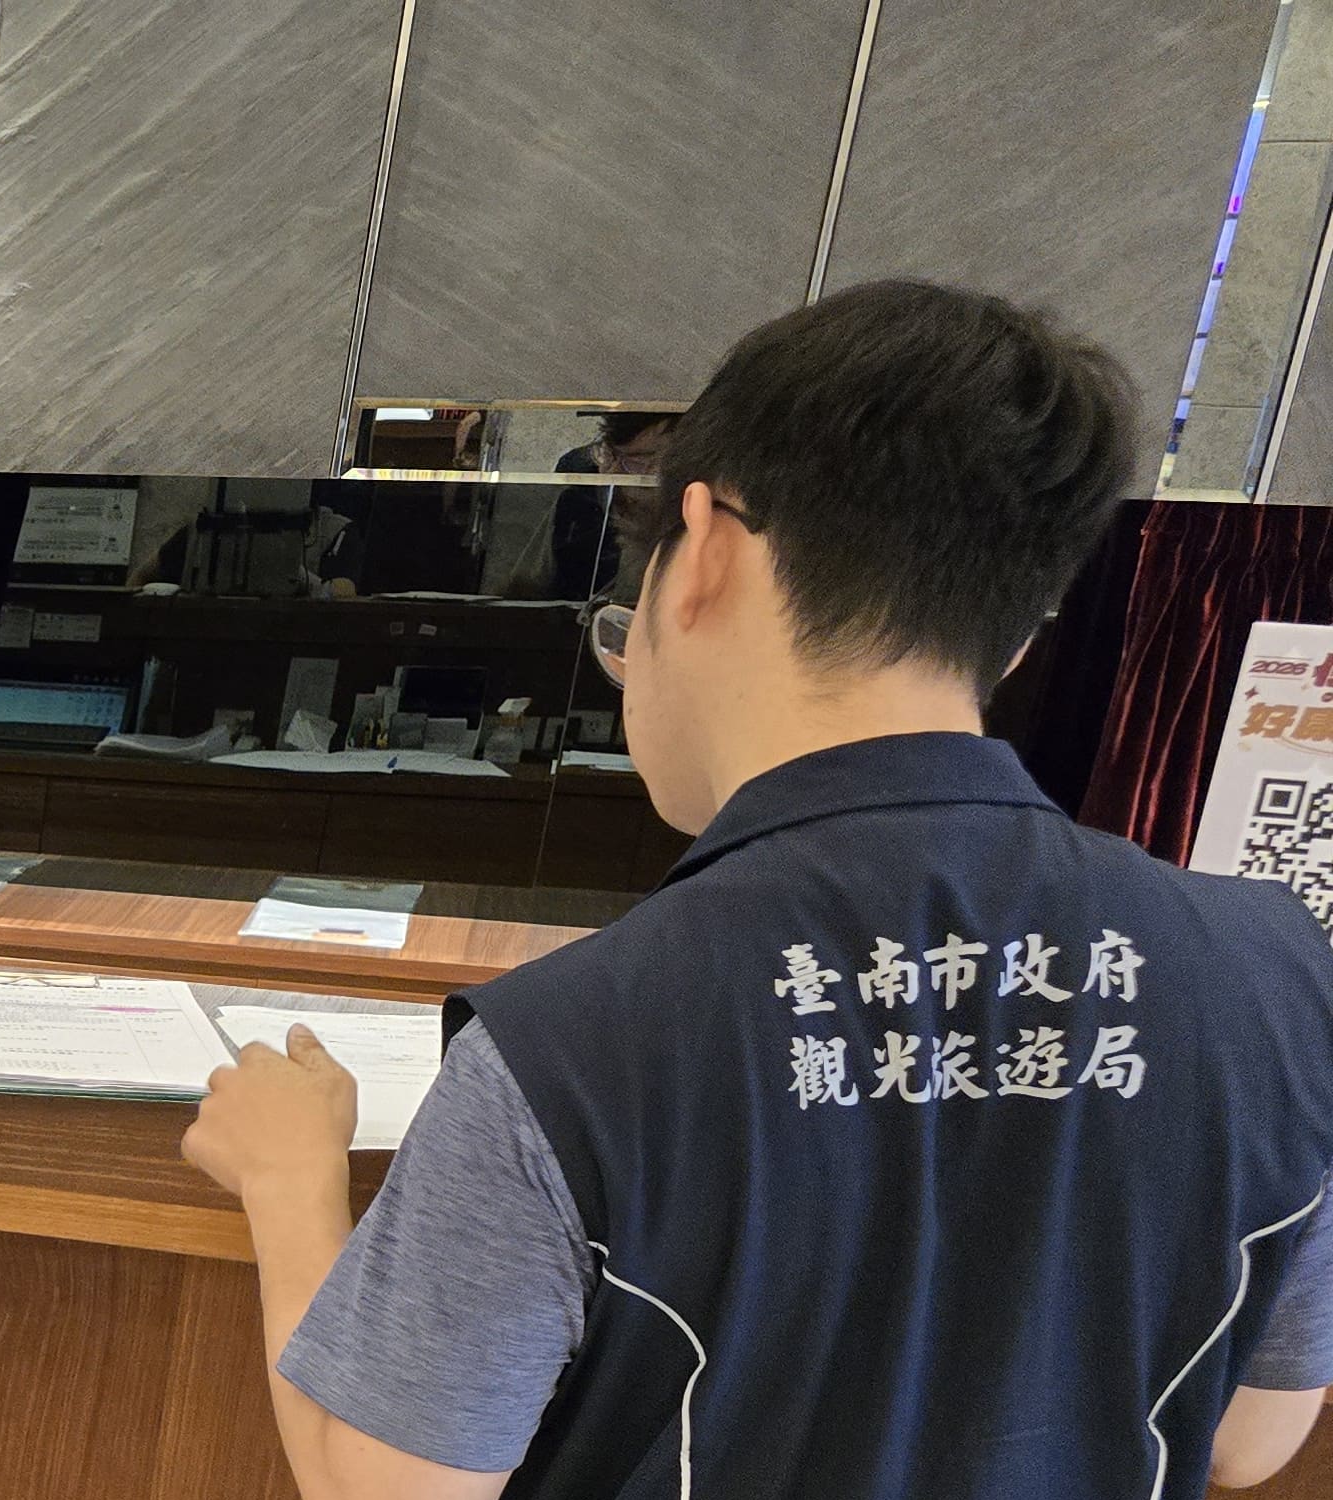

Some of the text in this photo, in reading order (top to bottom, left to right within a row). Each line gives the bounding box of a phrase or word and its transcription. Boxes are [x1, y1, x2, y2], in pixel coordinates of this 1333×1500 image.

[1248, 659, 1310, 676] 2026
[773, 928, 1148, 1016] 臺南市政府
[786, 1023, 1148, 1111] 觀光旅遊局
